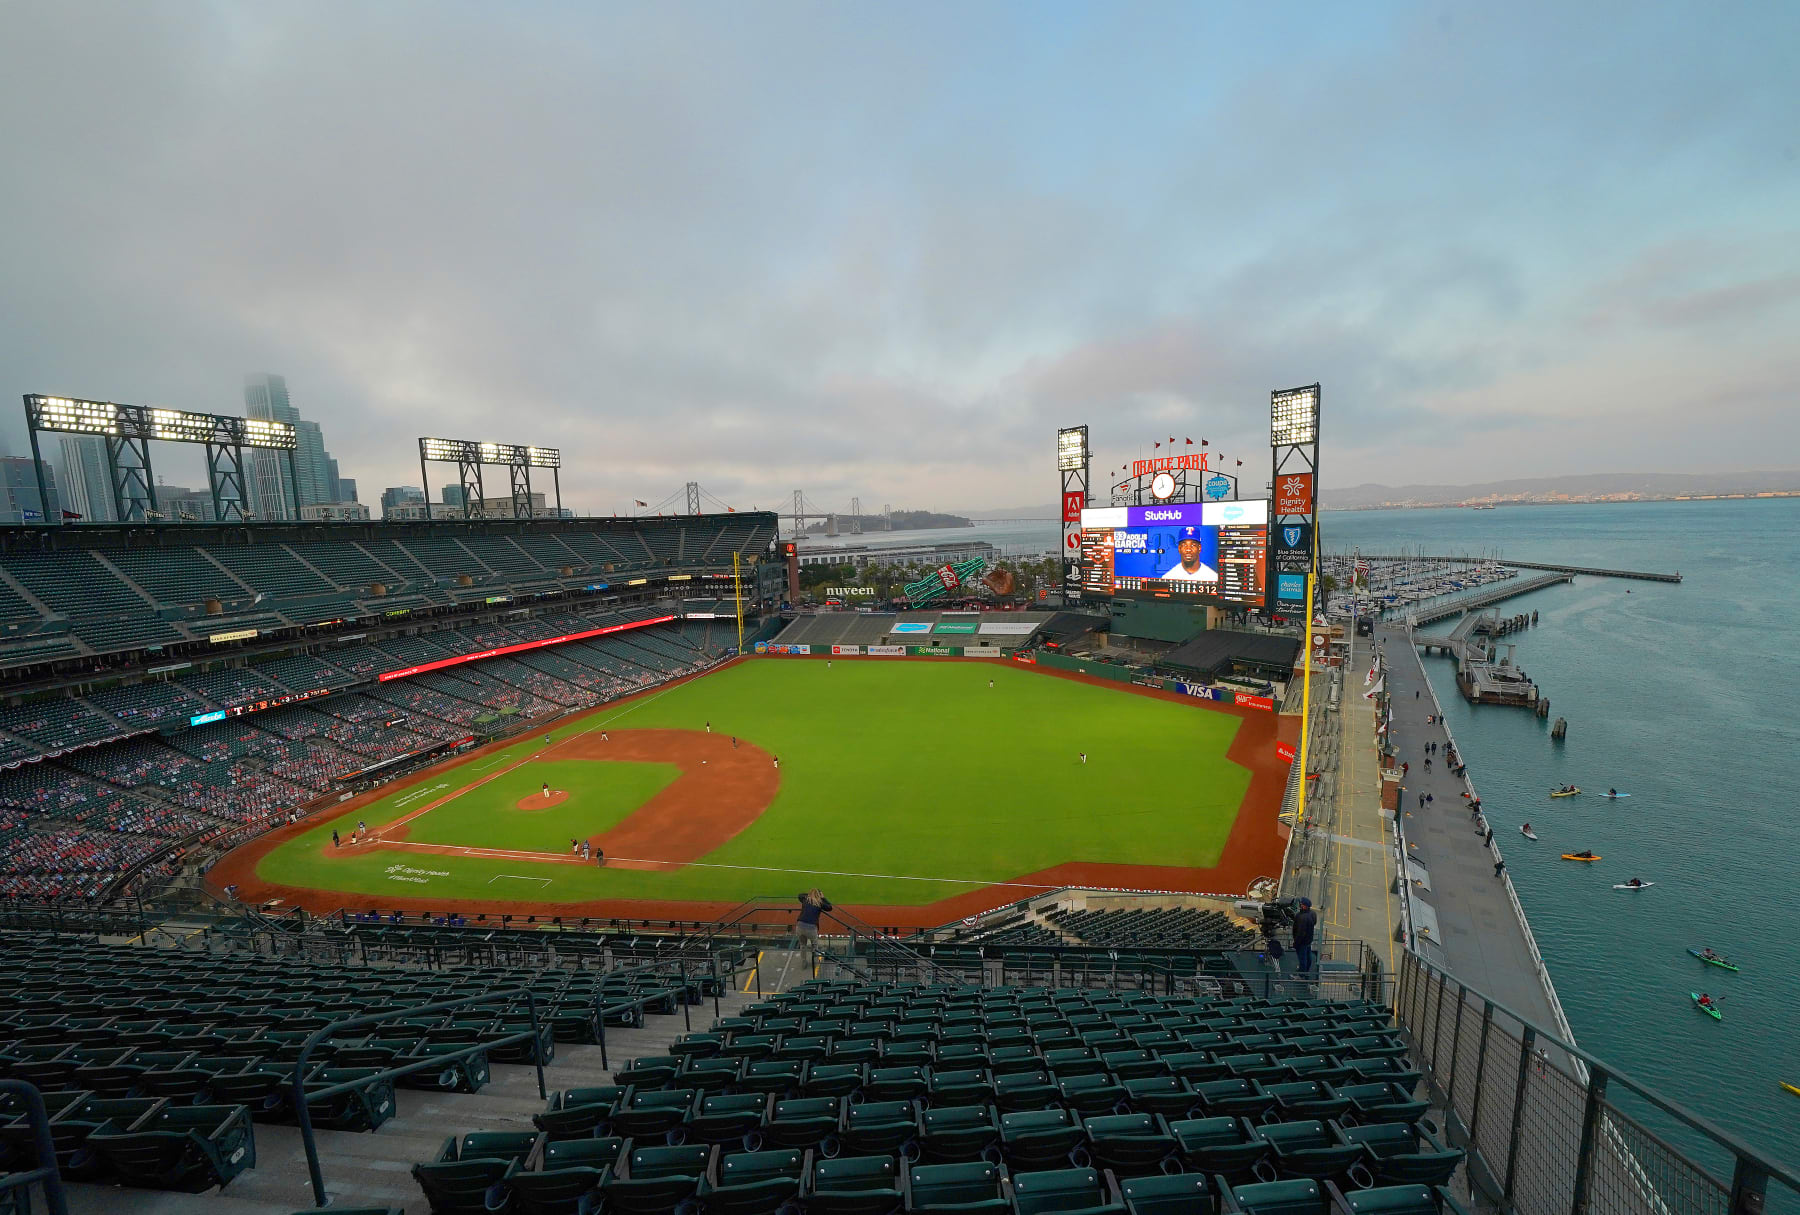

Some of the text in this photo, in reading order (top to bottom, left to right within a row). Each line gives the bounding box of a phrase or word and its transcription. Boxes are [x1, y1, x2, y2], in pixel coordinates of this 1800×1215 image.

[1133, 453, 1208, 478] ORACLE PARK
[1280, 498, 1306, 507] Dignity
[1144, 510, 1182, 521] StubHub
[826, 587, 875, 596] nuveen
[1198, 585, 1204, 593] 3
[1211, 586, 1217, 594] 2
[1184, 684, 1213, 700] VISA
